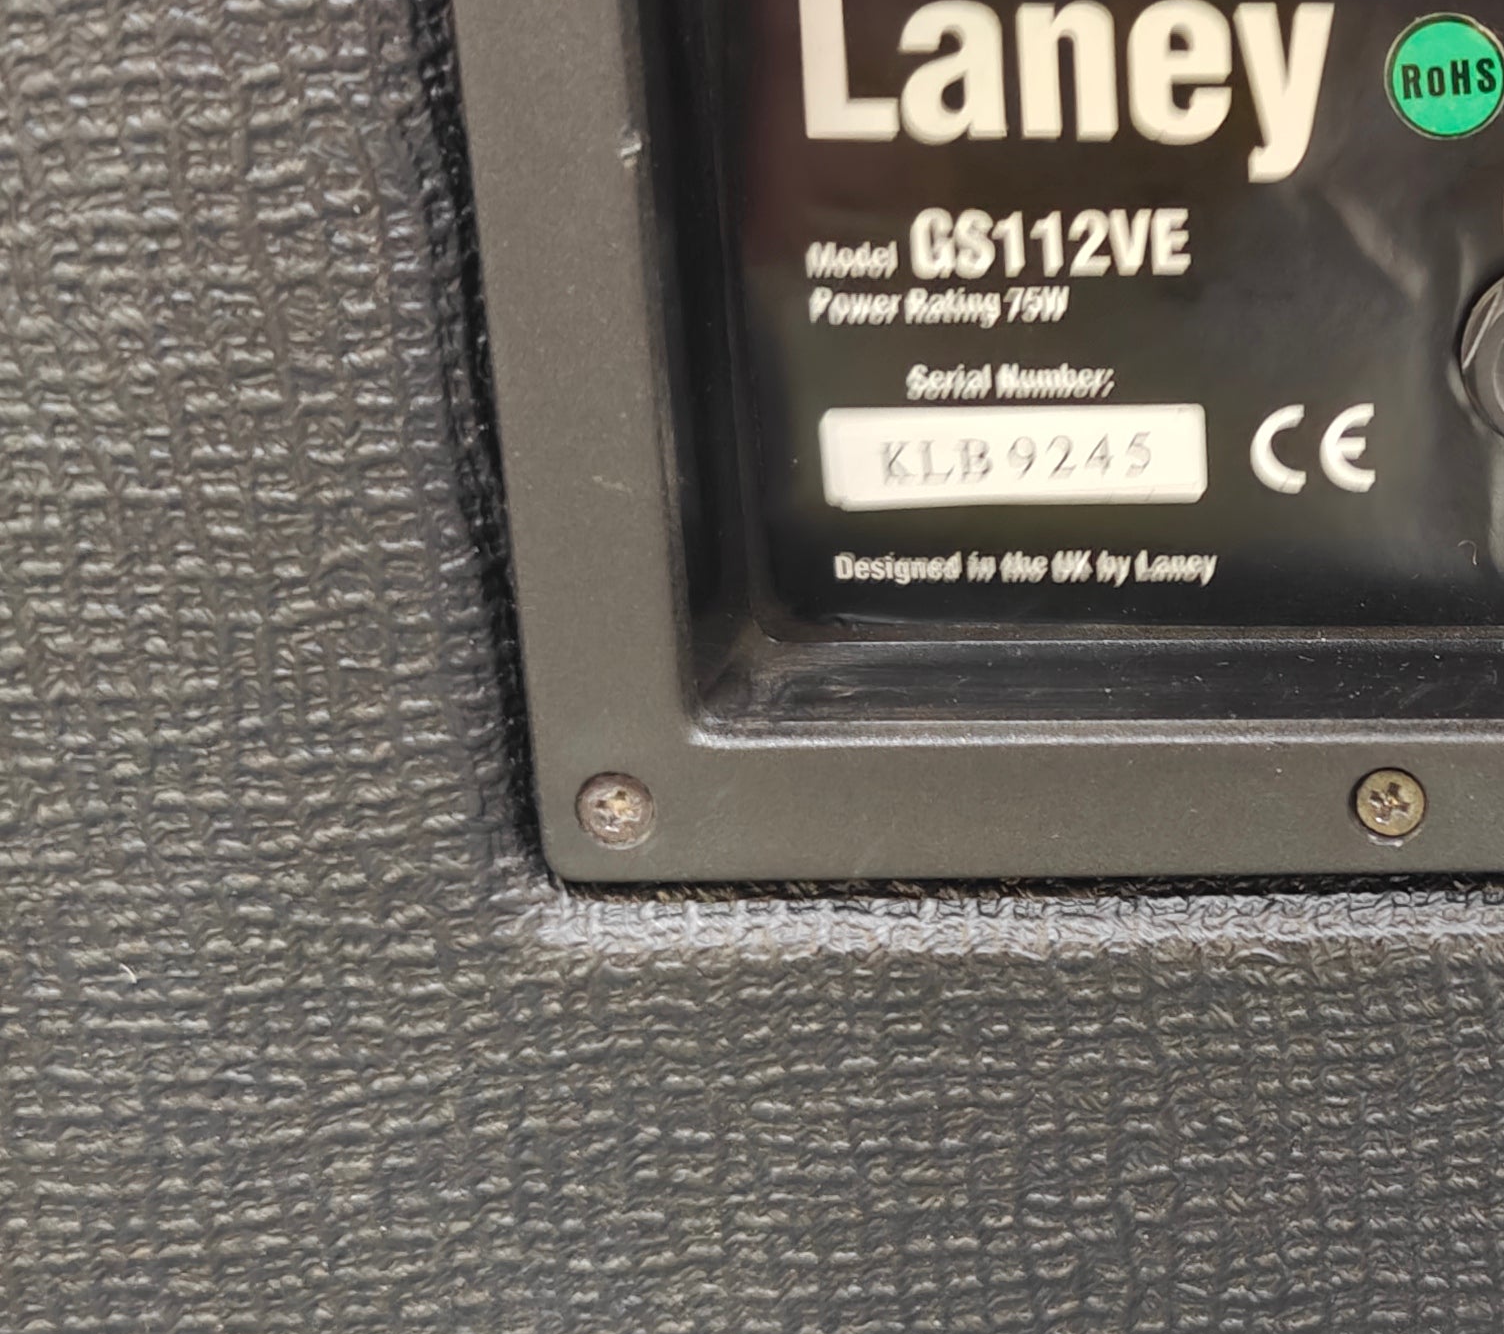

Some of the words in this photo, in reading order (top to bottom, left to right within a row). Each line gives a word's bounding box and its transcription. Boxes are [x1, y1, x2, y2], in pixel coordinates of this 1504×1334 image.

[1401, 57, 1497, 101] RoHS
[805, 241, 899, 278] Model
[909, 208, 1192, 279] GS112VE
[809, 286, 902, 325] Power
[904, 287, 1001, 328] Rating
[1003, 286, 1070, 323] 75W
[906, 364, 992, 400] Serial
[1250, 404, 1376, 494] CE
[833, 551, 963, 586] Designed
[967, 551, 998, 583] in
[1000, 550, 1049, 583] the
[1051, 550, 1093, 584] UK
[1096, 550, 1131, 588] by
[1134, 551, 1219, 588] Laney
